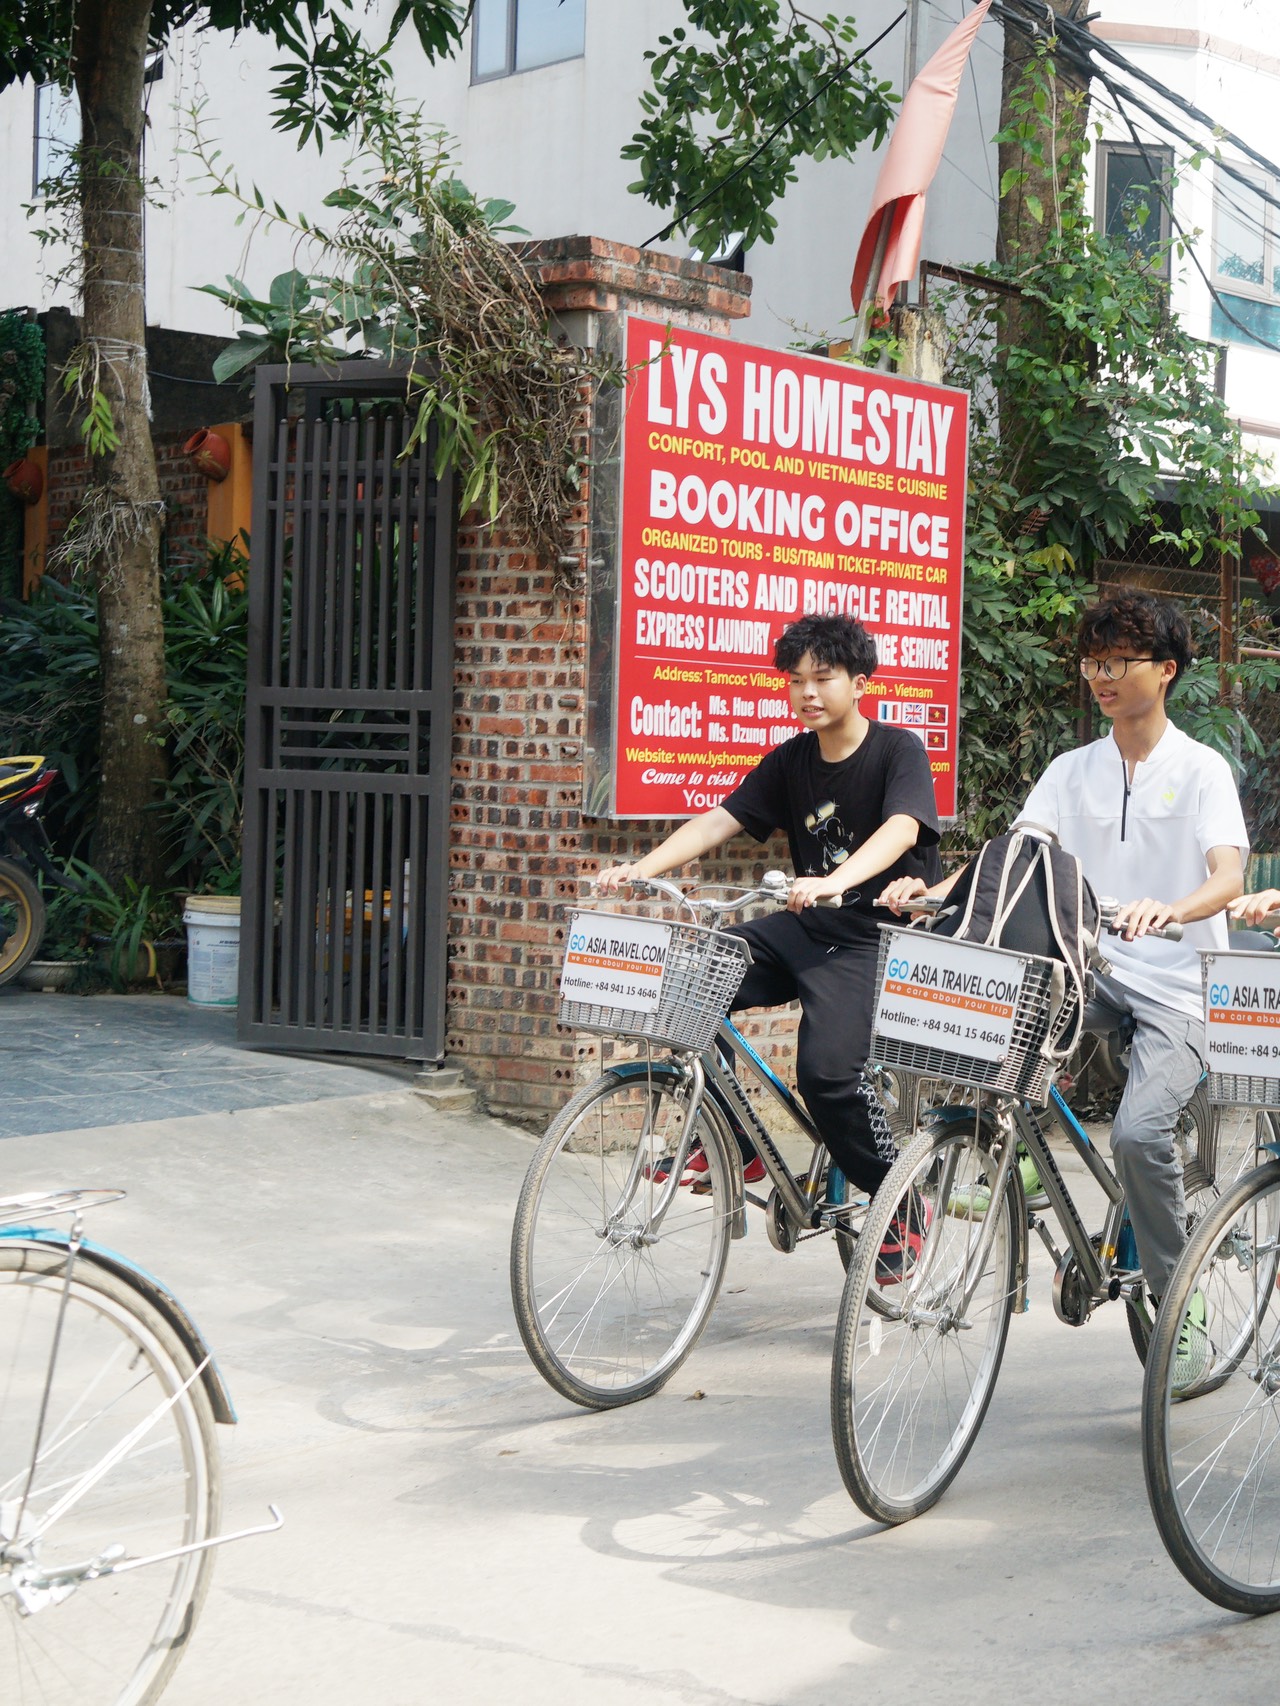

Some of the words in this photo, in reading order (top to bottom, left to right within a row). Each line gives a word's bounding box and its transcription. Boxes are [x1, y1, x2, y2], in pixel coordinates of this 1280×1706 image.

[647, 339, 728, 436] LYS
[742, 361, 954, 477] HOMESTAY
[648, 431, 727, 466] CONFORT,
[730, 448, 771, 471] POOL
[774, 454, 804, 476] AND
[808, 461, 894, 492] VIETNAMESE
[897, 476, 948, 501] CUISINE
[650, 469, 825, 542] BOOKING
[834, 500, 949, 560] OFFICE
[641, 527, 718, 556] ORGANIZED
[721, 538, 763, 562] TOURS
[773, 545, 835, 570] BUS/TRAIN
[837, 553, 924, 581] TICKET-PRIVATE
[925, 565, 948, 584] CAR
[634, 557, 749, 609] SCOOTERS
[754, 573, 798, 614] AND
[803, 579, 880, 624] BICYCLE
[886, 590, 950, 630] RENTAL
[636, 609, 704, 650] EXPRESS
[708, 617, 770, 656] LAUNDRY
[900, 635, 949, 671] SERVICE
[653, 666, 703, 683] Address:
[705, 670, 748, 686] Tamcoc
[750, 673, 785, 691] Village
[894, 683, 933, 698] Vietnam
[630, 695, 702, 738] Contact:
[708, 695, 730, 716] Ms.
[732, 697, 755, 717] Hue
[757, 699, 788, 719] (0084
[708, 722, 729, 743] Ms.
[732, 723, 766, 746] Dzung
[625, 747, 675, 763] Website:
[678, 750, 764, 768] www.lyshomest
[641, 768, 686, 785] Come
[688, 771, 703, 785] to
[707, 770, 738, 786] visit
[570, 934, 586, 951] GO
[586, 937, 607, 954] ASIA
[609, 939, 666, 964] TRAVEL.COM
[570, 954, 581, 962] we
[602, 959, 624, 969] about
[626, 963, 643, 973] your
[645, 964, 659, 975] trip
[564, 976, 594, 990] Hotline:
[594, 981, 609, 992] +84
[610, 983, 624, 994] 941
[626, 985, 636, 995] 15
[637, 986, 657, 1000] 4646
[888, 958, 909, 980] GO
[910, 963, 938, 987] ASIA
[941, 969, 1018, 1004] TRAVEL.COM
[1209, 984, 1230, 1007] GO
[1232, 985, 1260, 1008] ASIA
[890, 983, 902, 992] we
[906, 986, 928, 997] care
[932, 992, 961, 1005] about
[964, 999, 987, 1012] your
[990, 1003, 1009, 1016] trip
[880, 1008, 920, 1027] Hotline:
[922, 1018, 941, 1031] +84
[943, 1022, 962, 1036] 941
[964, 1027, 978, 1040] 15
[979, 1030, 1006, 1046] 4646
[1213, 1012, 1226, 1020] we
[1230, 1012, 1252, 1022] care
[1209, 1040, 1248, 1056] Hotline:
[1250, 1045, 1269, 1058] +84
